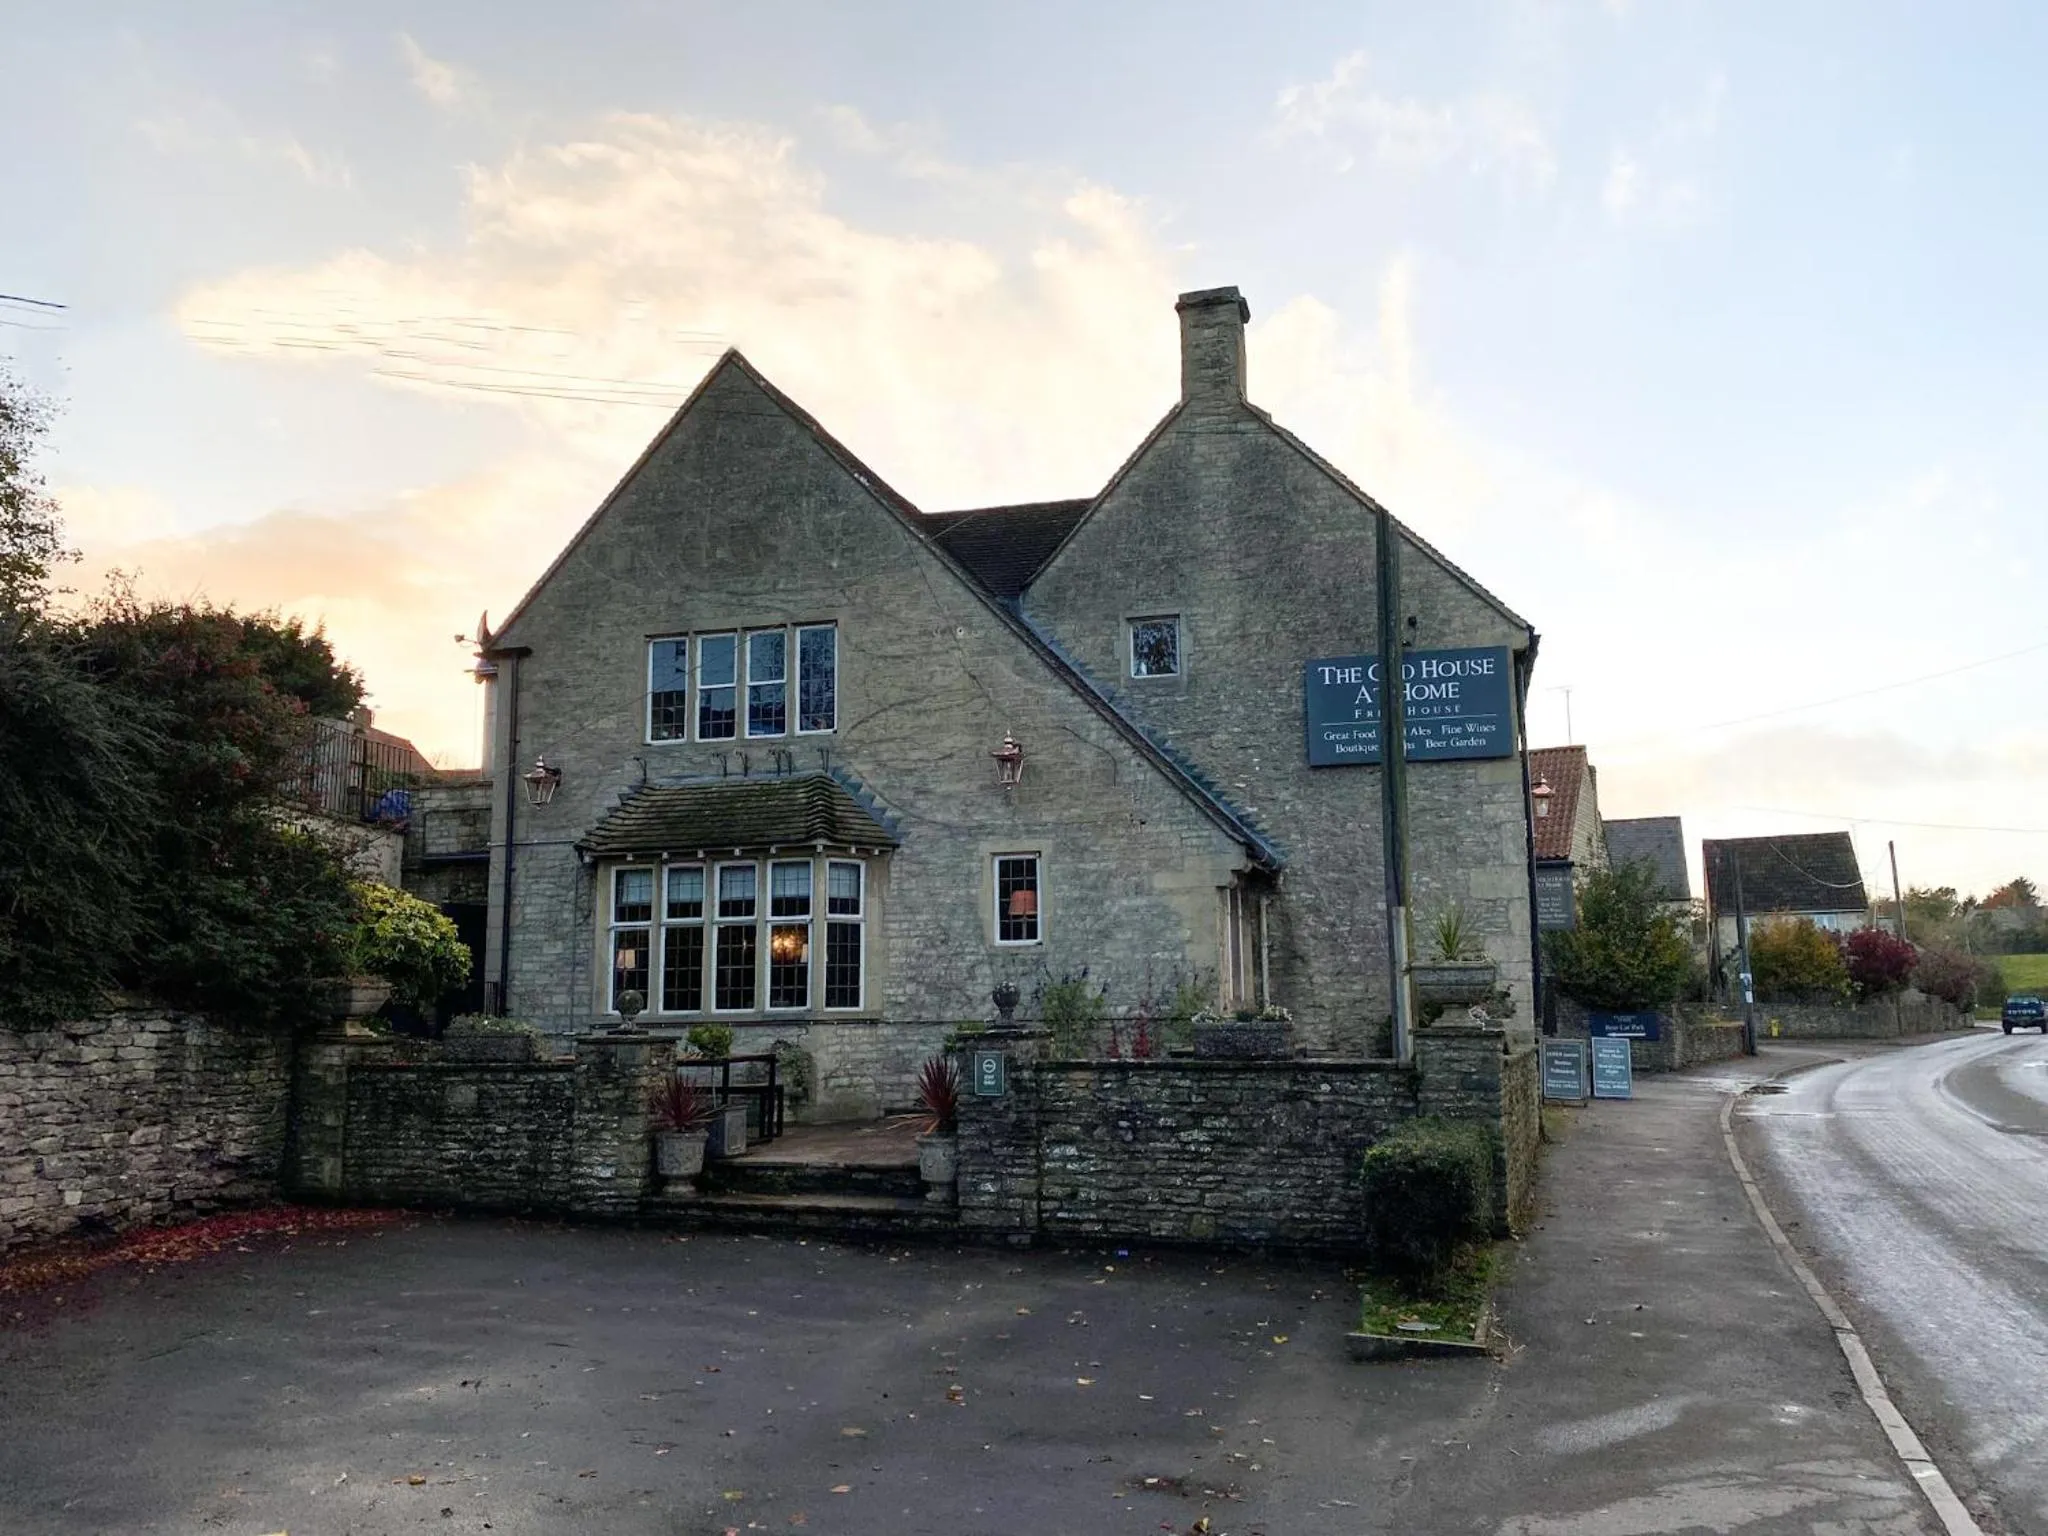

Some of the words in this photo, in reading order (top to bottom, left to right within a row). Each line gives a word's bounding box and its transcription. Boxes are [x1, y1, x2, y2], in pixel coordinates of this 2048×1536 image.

[1318, 666, 1363, 685] THE
[1367, 662, 1415, 682] OD
[1421, 658, 1495, 678] HOUSE
[1354, 684, 1381, 705] A
[1407, 703, 1461, 716] HOUSE
[1323, 730, 1350, 741] Great
[1352, 728, 1377, 740] Food
[1410, 725, 1432, 737] Ales
[1441, 724, 1463, 735] Fine
[1465, 722, 1497, 733] Wines
[1335, 743, 1381, 755] Boutique
[1425, 738, 1448, 749] Beer
[1450, 736, 1487, 748] Garden
